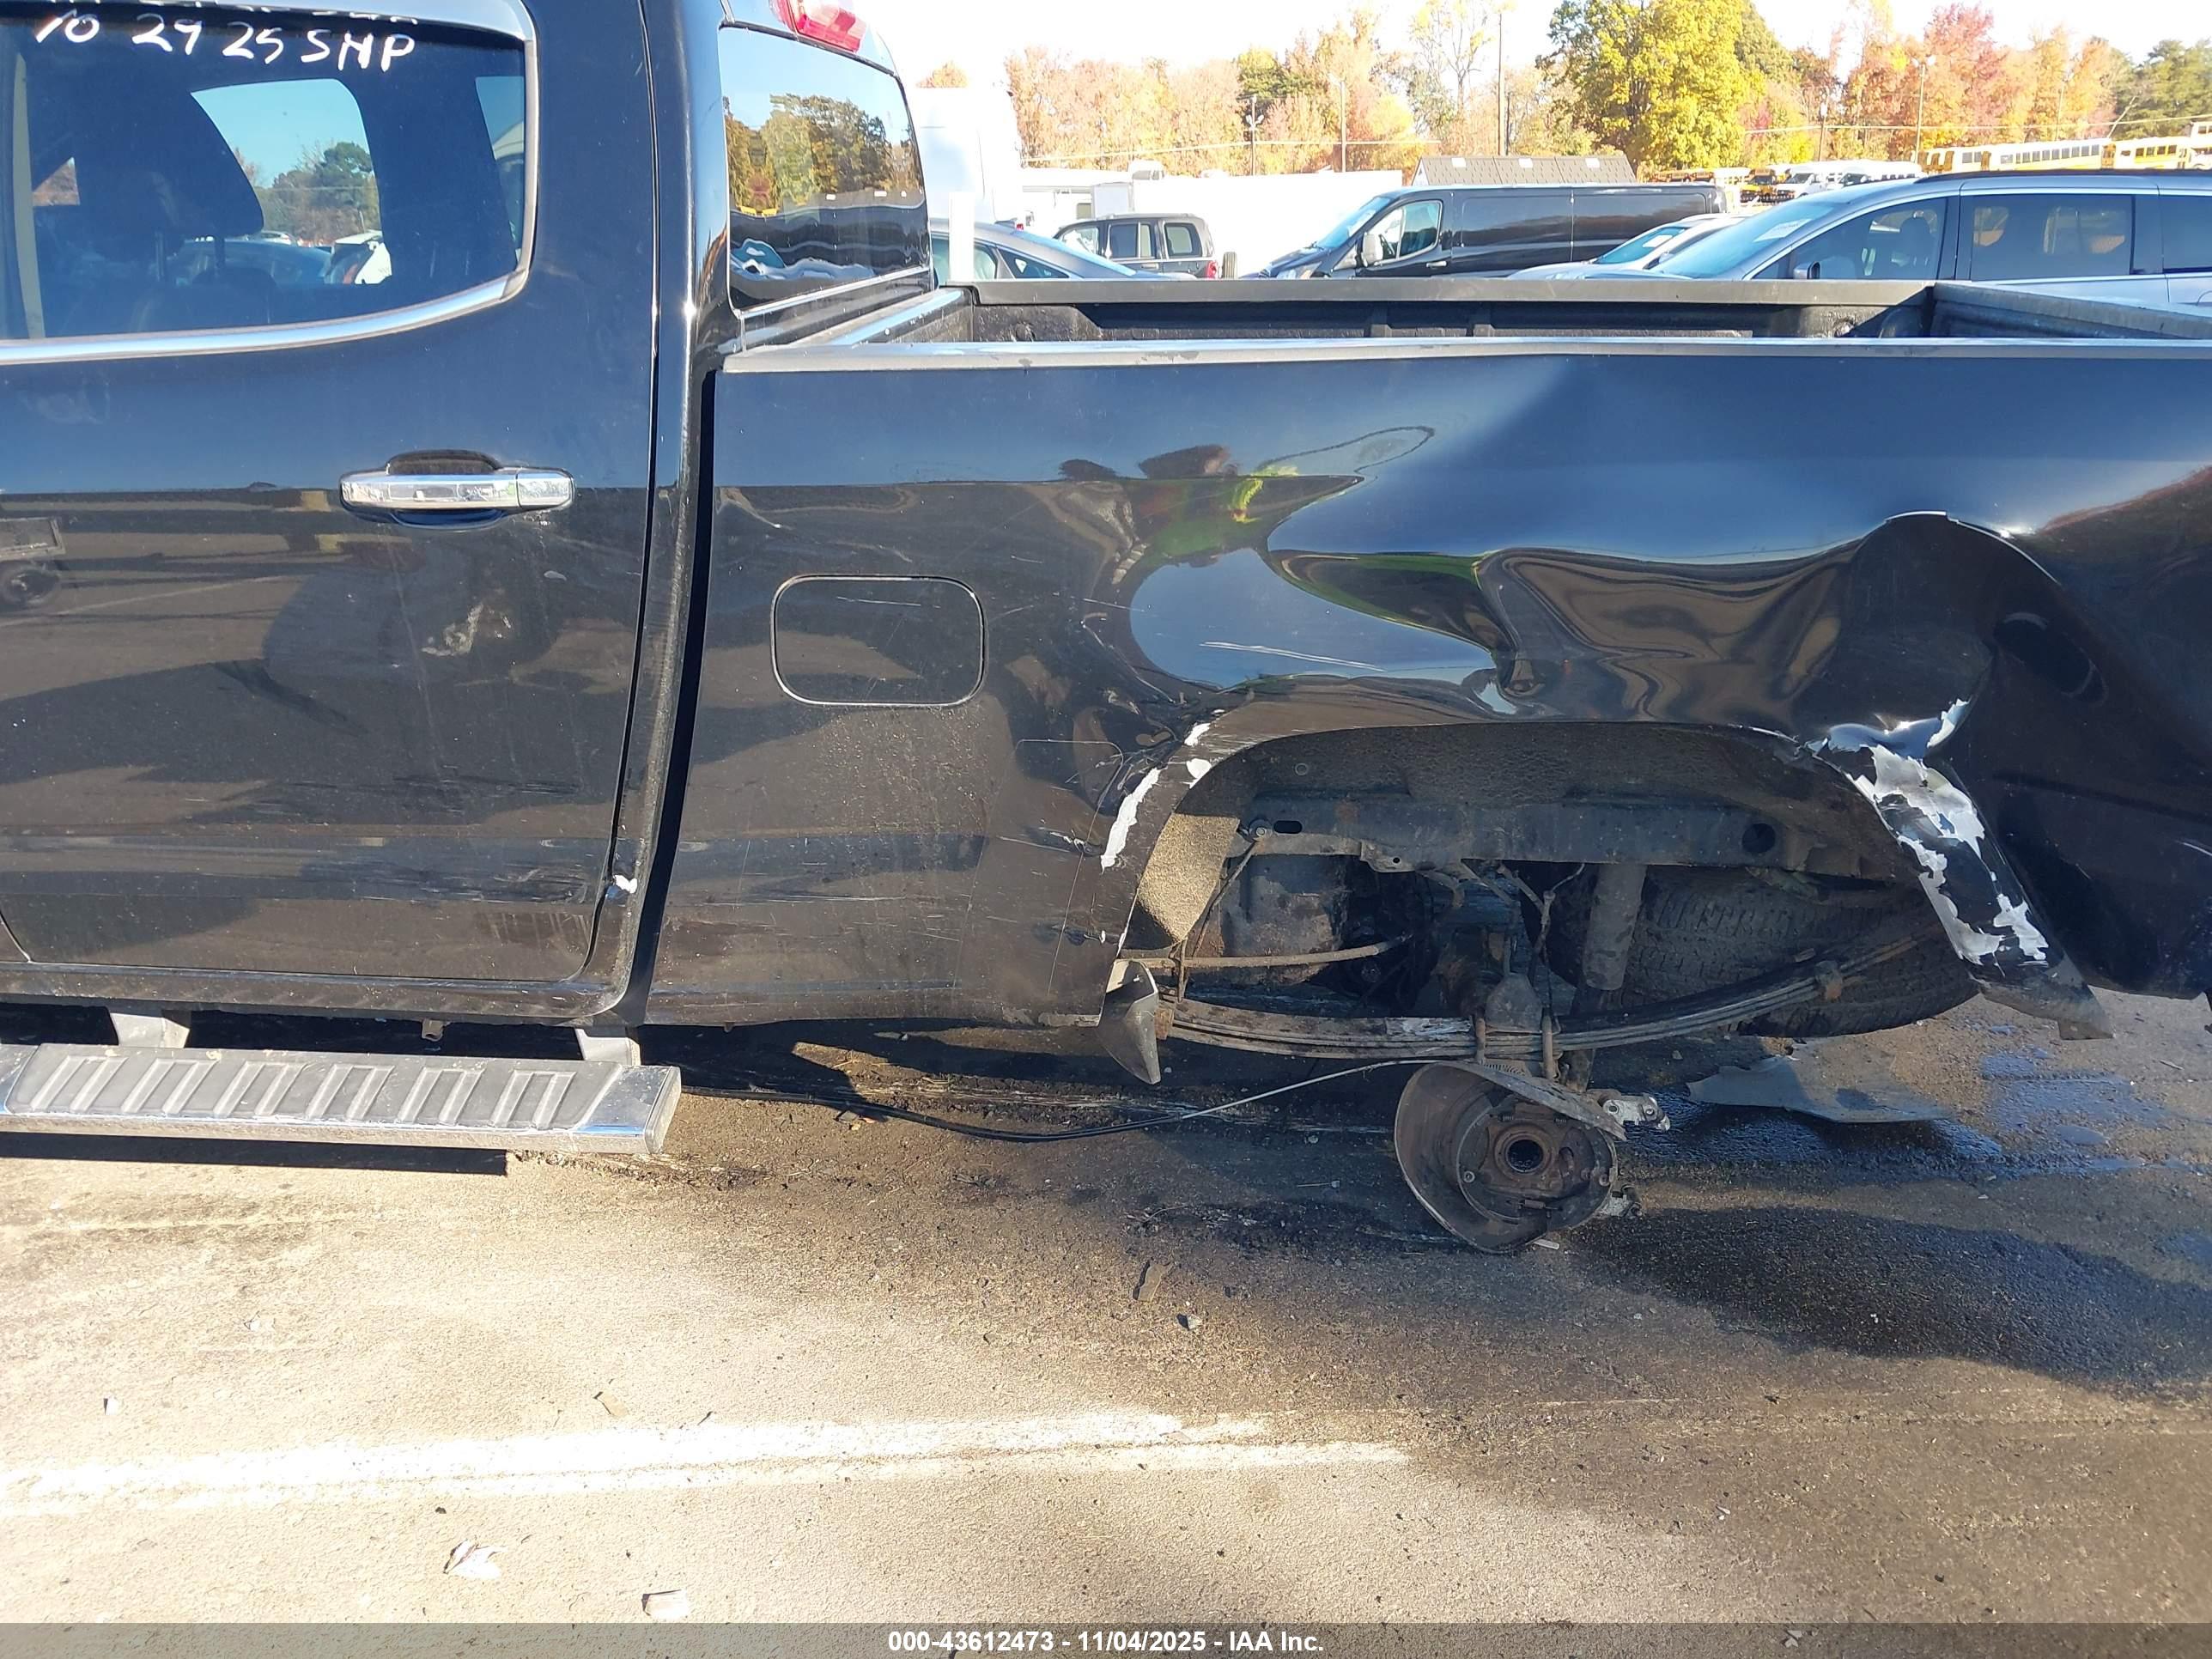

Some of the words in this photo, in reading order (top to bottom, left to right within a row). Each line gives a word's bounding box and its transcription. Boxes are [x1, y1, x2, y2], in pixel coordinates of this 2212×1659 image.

[35, 9, 100, 43] 10
[131, 13, 203, 55] 29
[222, 21, 284, 64] 25
